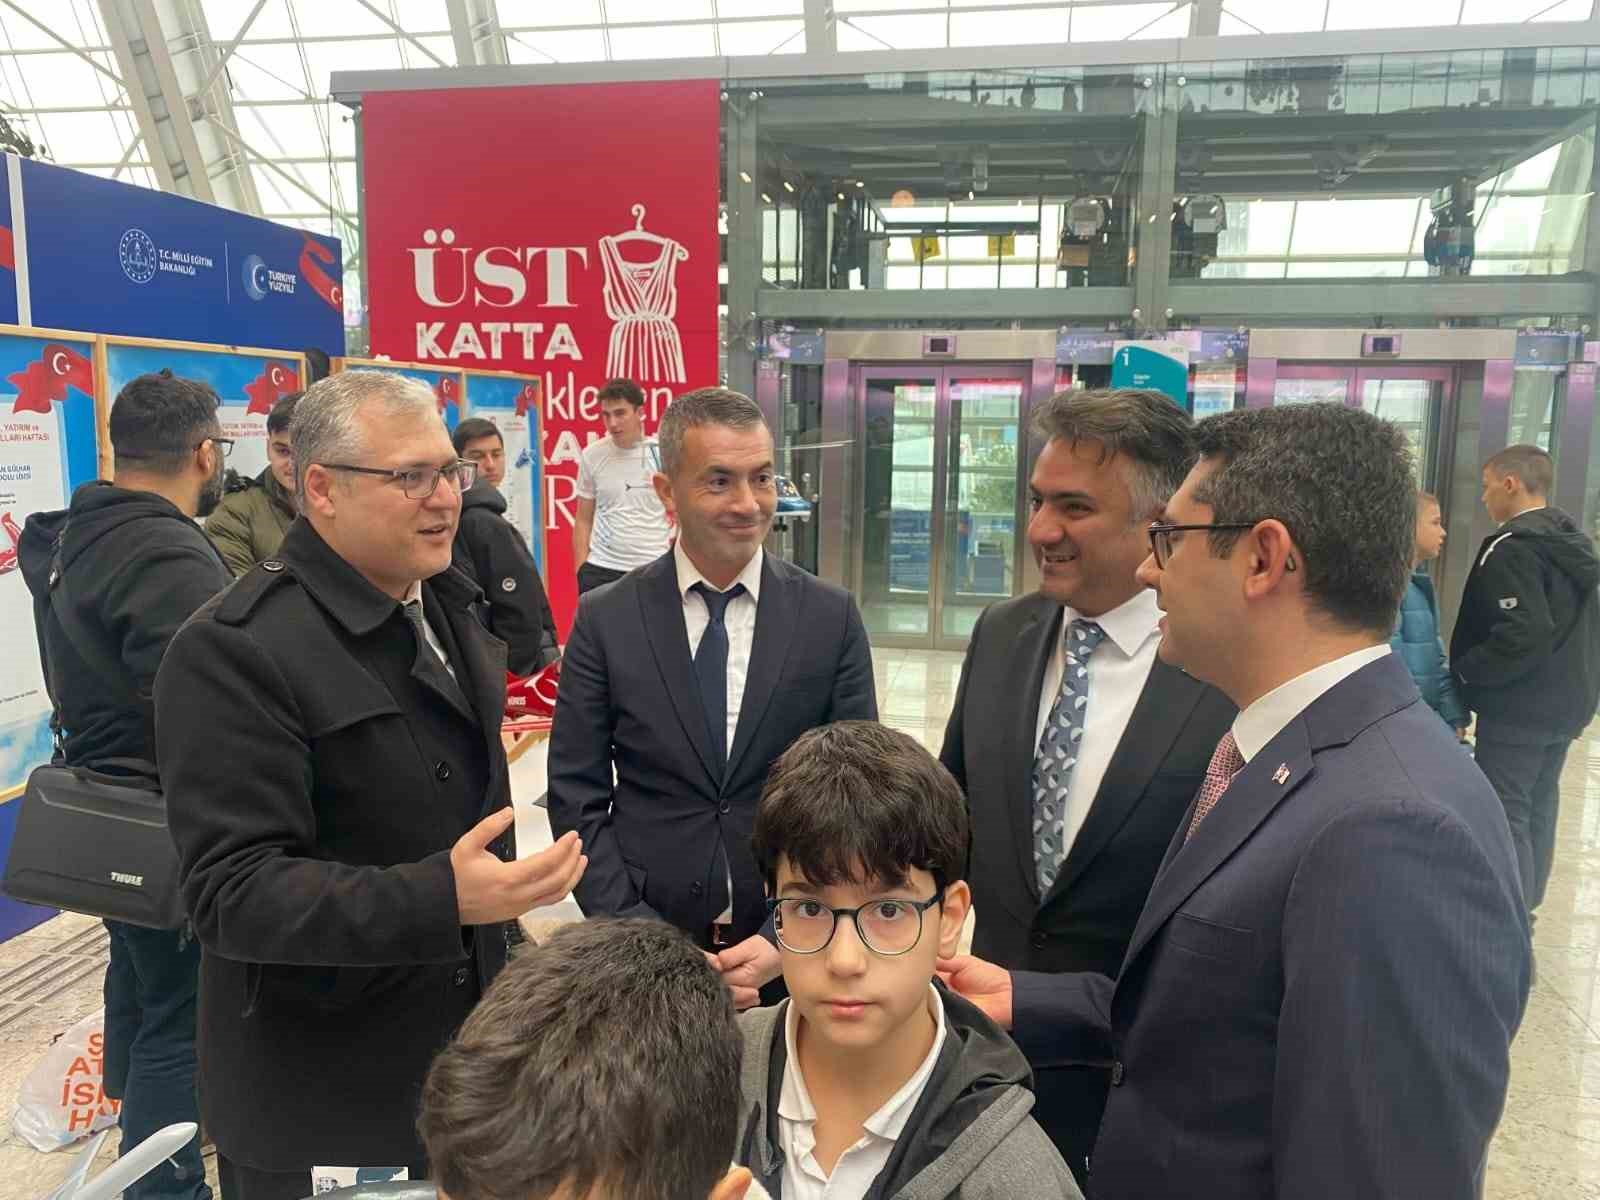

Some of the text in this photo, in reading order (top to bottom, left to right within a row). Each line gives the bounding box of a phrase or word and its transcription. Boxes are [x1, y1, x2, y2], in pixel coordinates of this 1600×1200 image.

[407, 228, 588, 307] ÜST
[416, 322, 583, 361] KATTA
[111, 871, 144, 887] THULE
